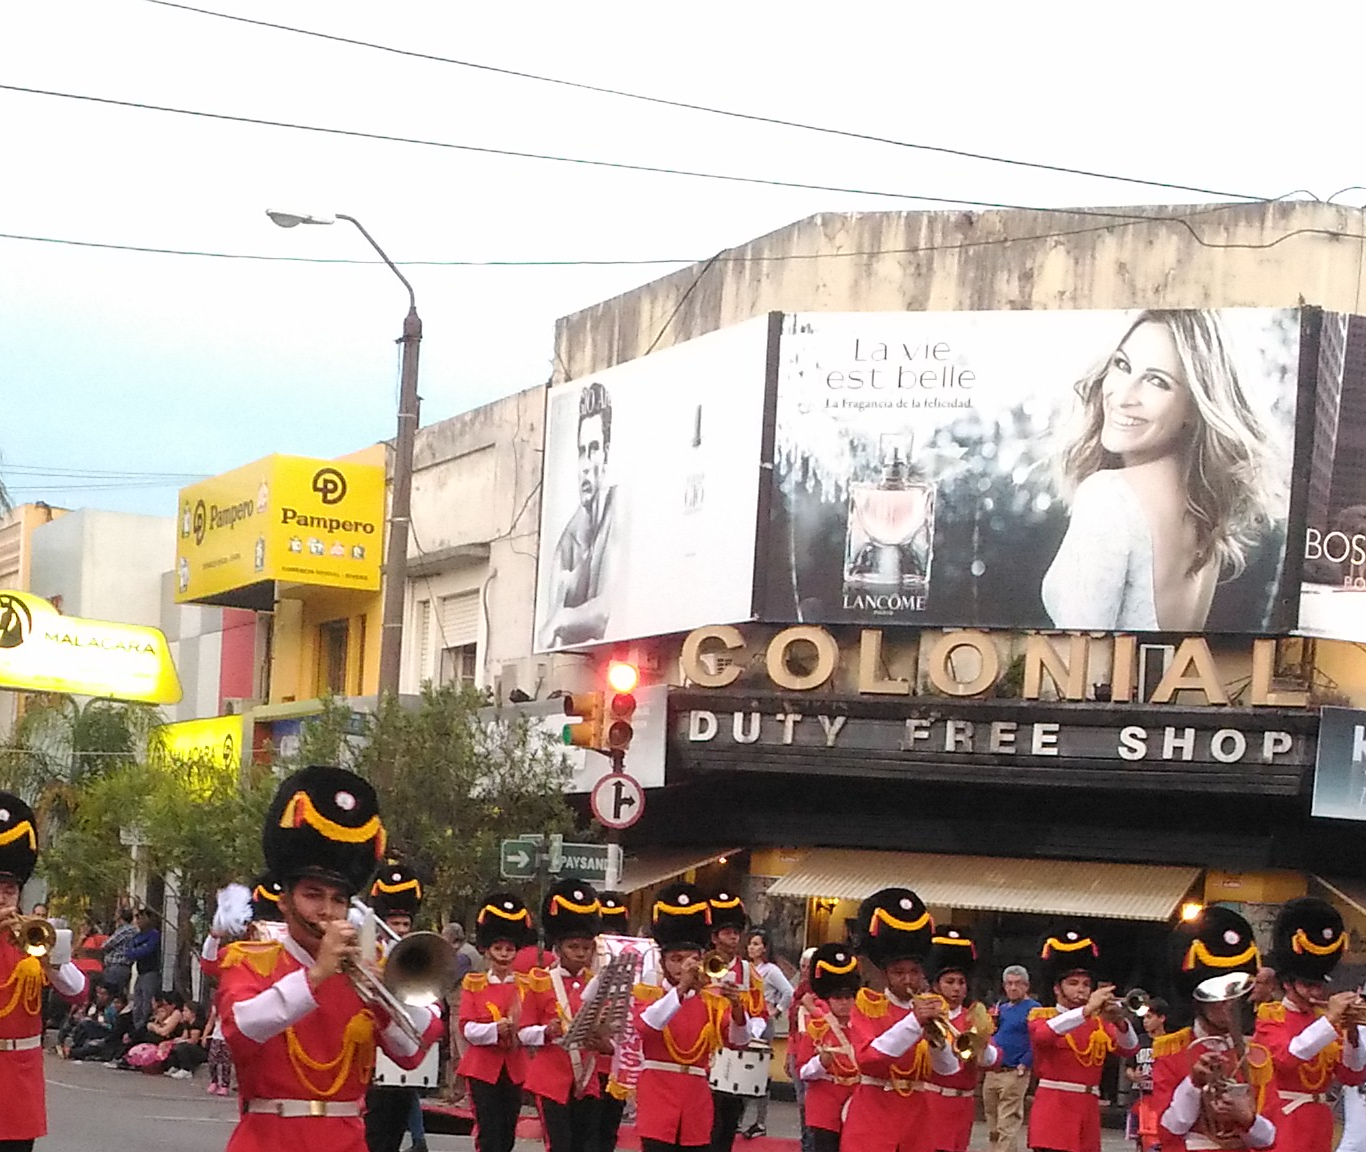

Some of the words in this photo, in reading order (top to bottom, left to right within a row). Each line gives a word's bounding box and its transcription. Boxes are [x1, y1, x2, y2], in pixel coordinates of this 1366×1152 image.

[854, 338, 888, 362] La
[902, 336, 951, 361] vie
[826, 368, 885, 390] est
[897, 365, 976, 390] belle
[209, 498, 255, 531] Pampero
[281, 507, 376, 535] Pampero
[44, 630, 157, 656] MALACARA
[681, 624, 1311, 707] COLONIAL
[688, 709, 848, 748] DUTY
[903, 717, 1061, 756] FREE
[1116, 724, 1294, 765] SHOP
[560, 854, 611, 870] PAYSAND
